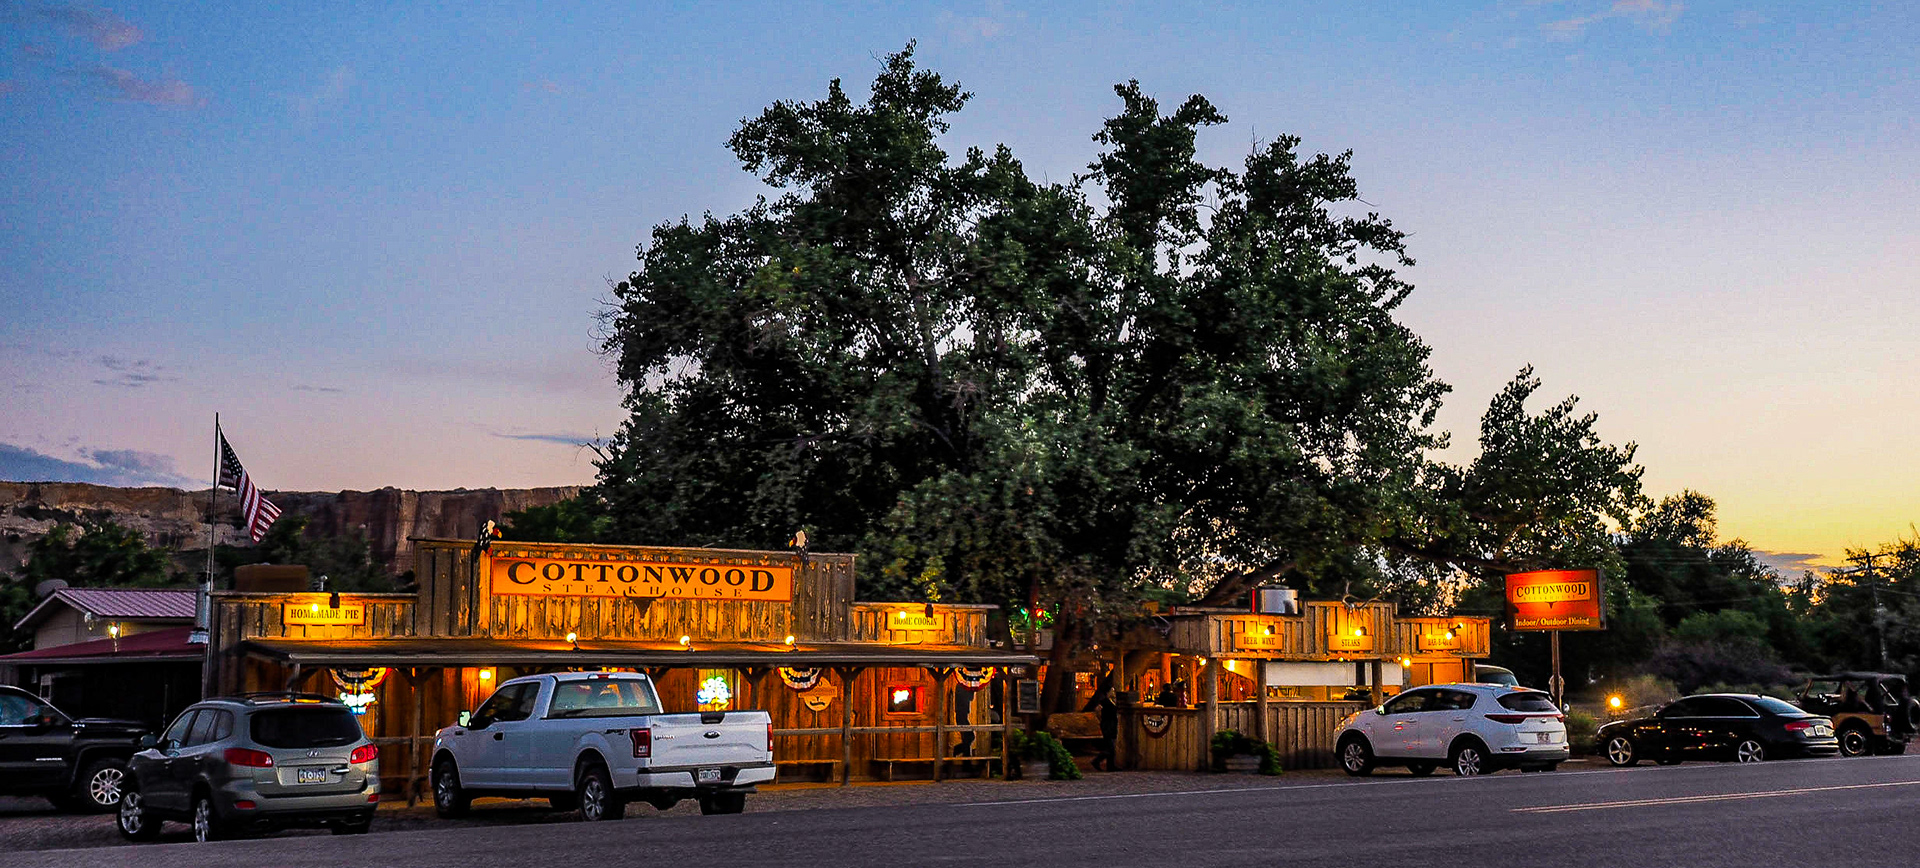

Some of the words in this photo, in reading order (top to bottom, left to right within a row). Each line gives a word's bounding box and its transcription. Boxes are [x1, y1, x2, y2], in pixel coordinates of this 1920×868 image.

[507, 561, 775, 592] COTTONWOOD
[542, 583, 743, 598] STEAKHOUSE
[1516, 583, 1587, 598] COTTONWOOD
[344, 609, 359, 619] PIE
[894, 616, 913, 626] HOME
